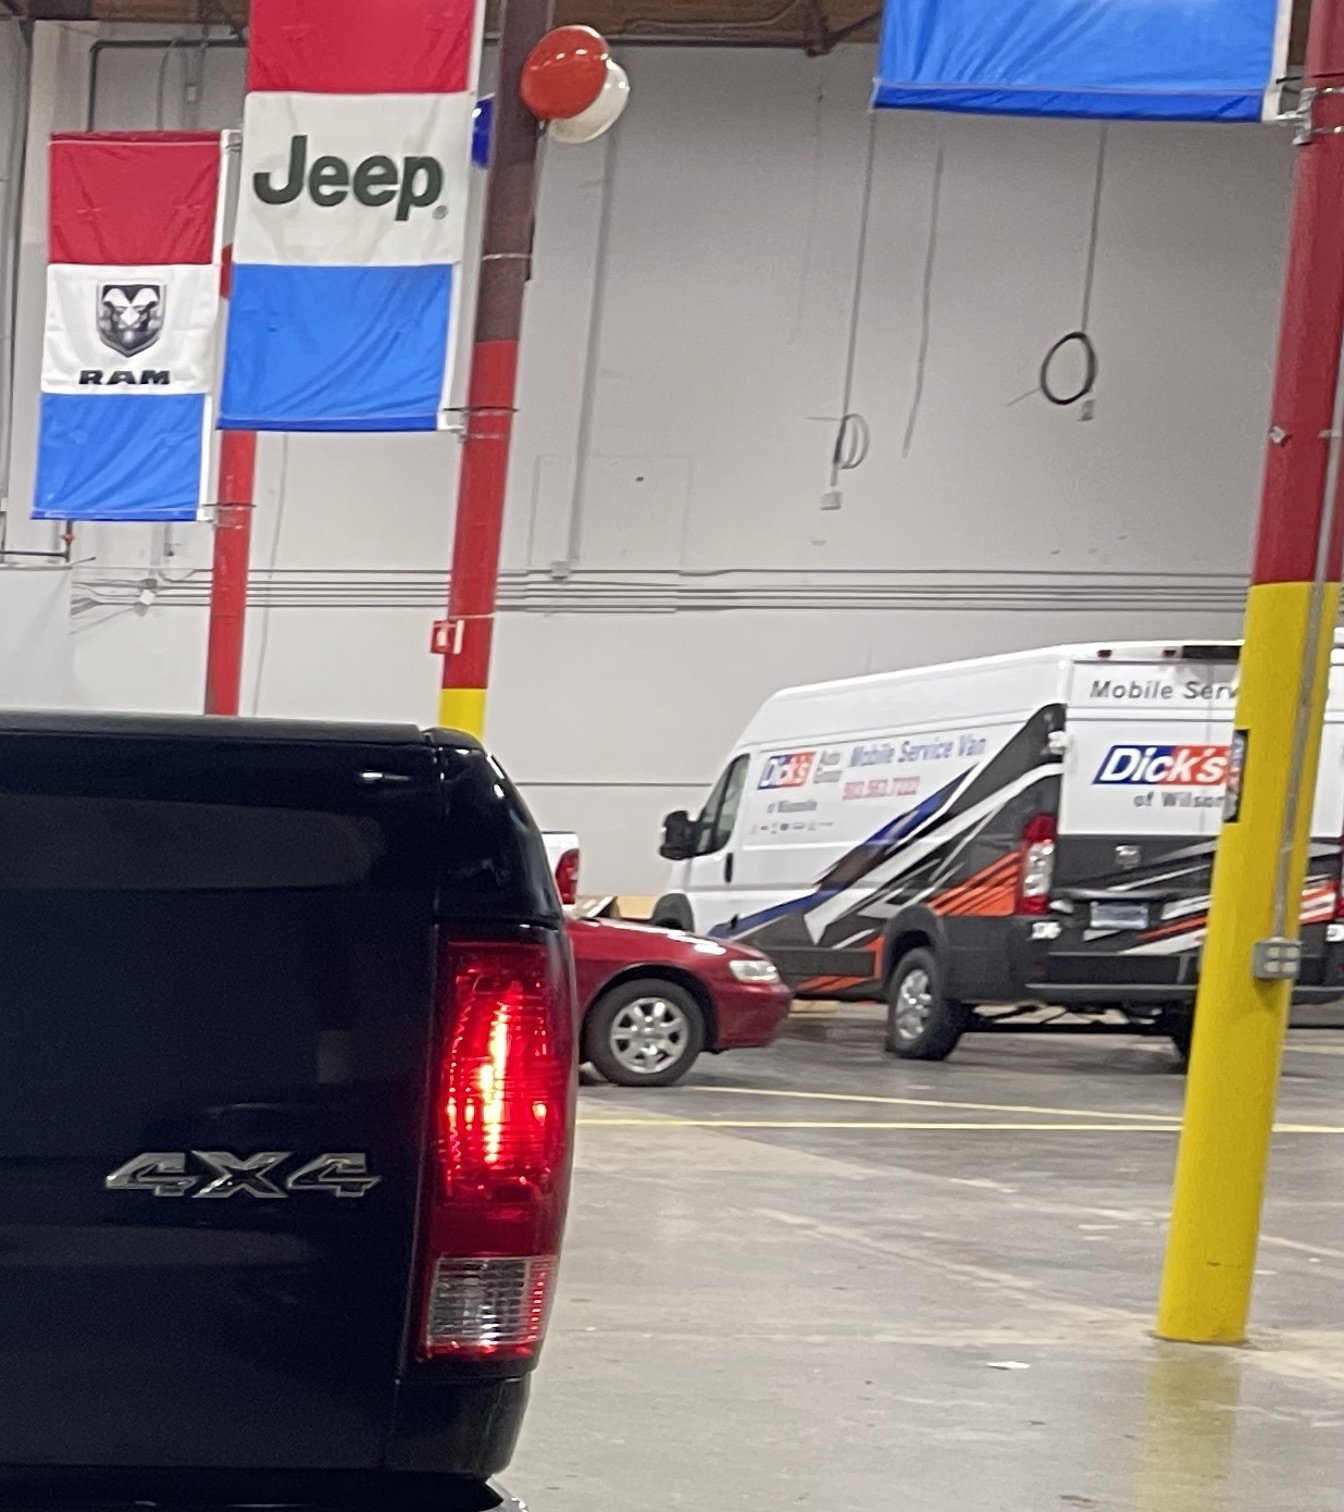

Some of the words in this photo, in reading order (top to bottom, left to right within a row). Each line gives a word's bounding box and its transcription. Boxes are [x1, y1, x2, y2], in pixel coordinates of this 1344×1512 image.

[253, 134, 444, 221] Jeep
[78, 370, 170, 386] RAM
[1089, 680, 1174, 699] Mobile
[1184, 680, 1241, 699] Serv
[898, 738, 953, 763] Service
[958, 734, 986, 757] Van
[1100, 747, 1227, 782] Dick's
[1133, 792, 1155, 807] of
[106, 1150, 382, 1198] 4X4
